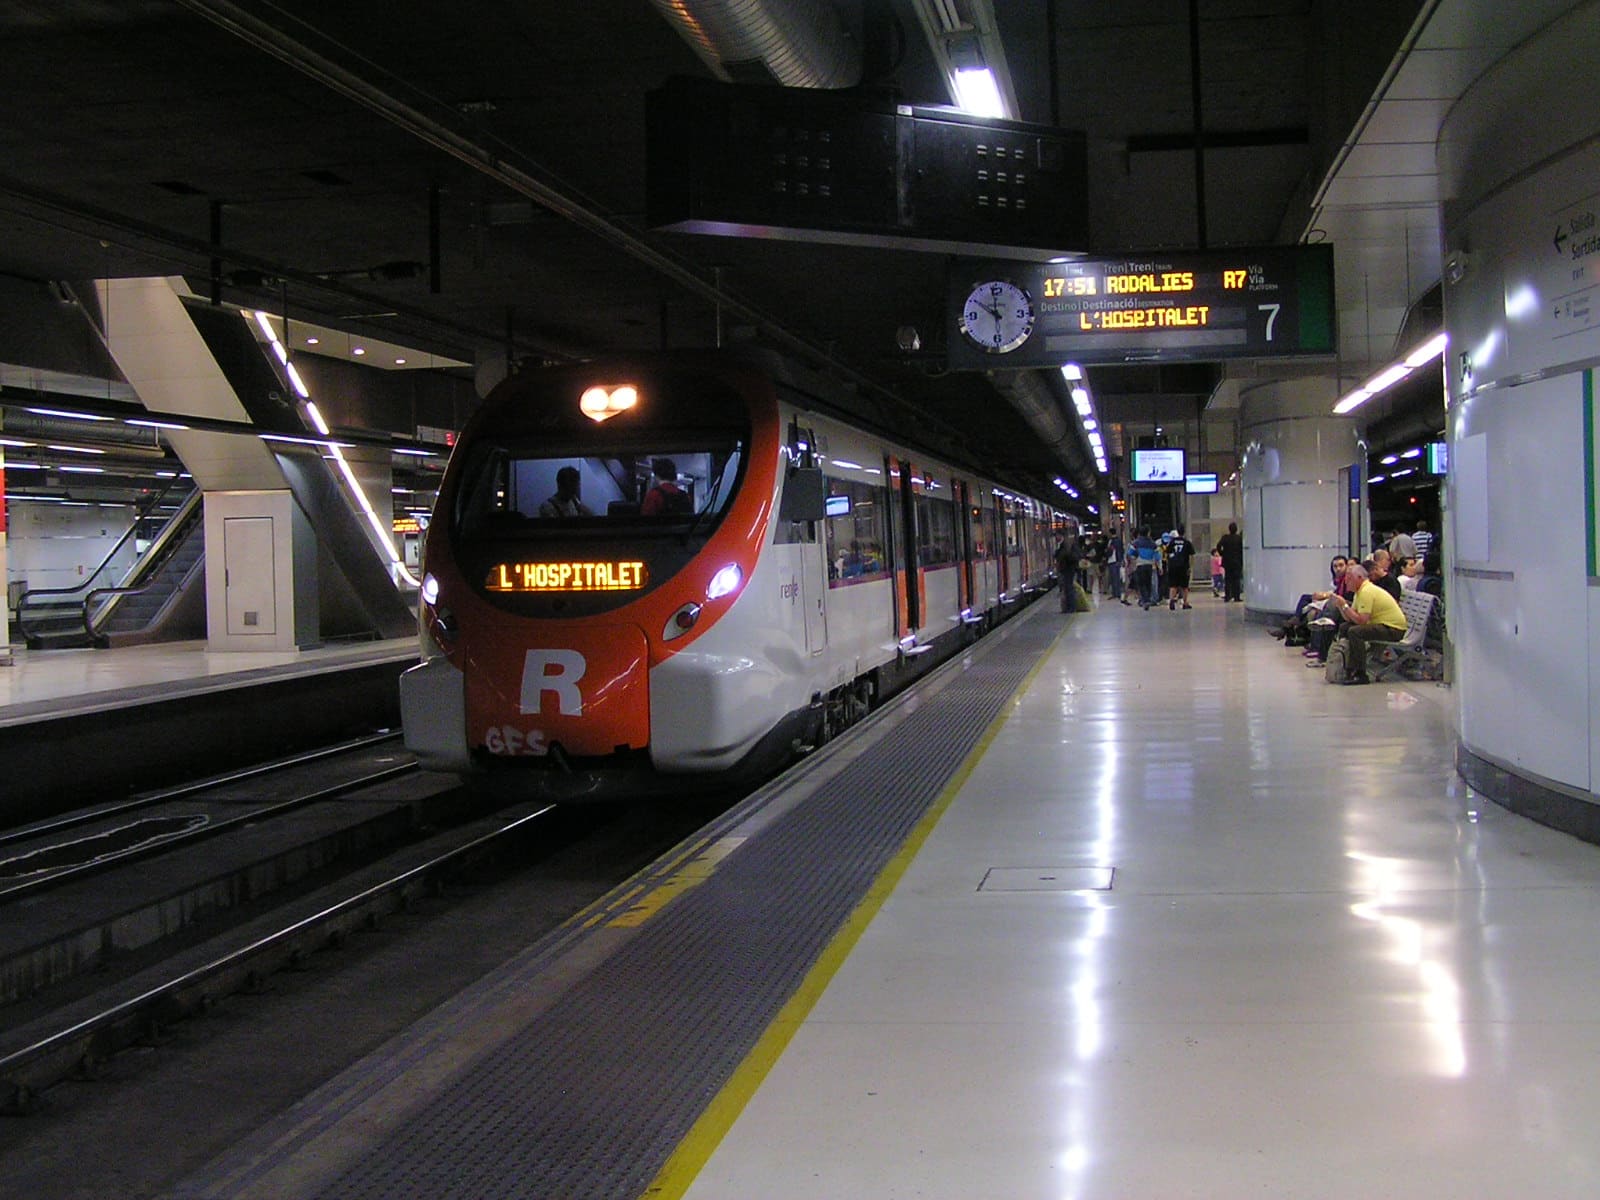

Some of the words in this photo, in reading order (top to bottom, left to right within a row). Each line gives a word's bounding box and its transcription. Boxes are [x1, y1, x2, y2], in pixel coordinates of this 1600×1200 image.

[1129, 262, 1152, 273] Tren
[1044, 277, 1097, 297] 17:51
[1106, 272, 1194, 294] RODALIES
[1223, 270, 1247, 289] R7
[969, 311, 978, 321] 9
[1016, 309, 1025, 319] 3
[1040, 301, 1077, 312] Destino
[1082, 298, 1135, 310] Destinació
[1080, 306, 1209, 330] L'HOSPITALET
[1258, 303, 1281, 342] 7
[993, 334, 1002, 343] 6
[500, 562, 644, 588] L'HOSPITALET
[520, 648, 587, 717] R
